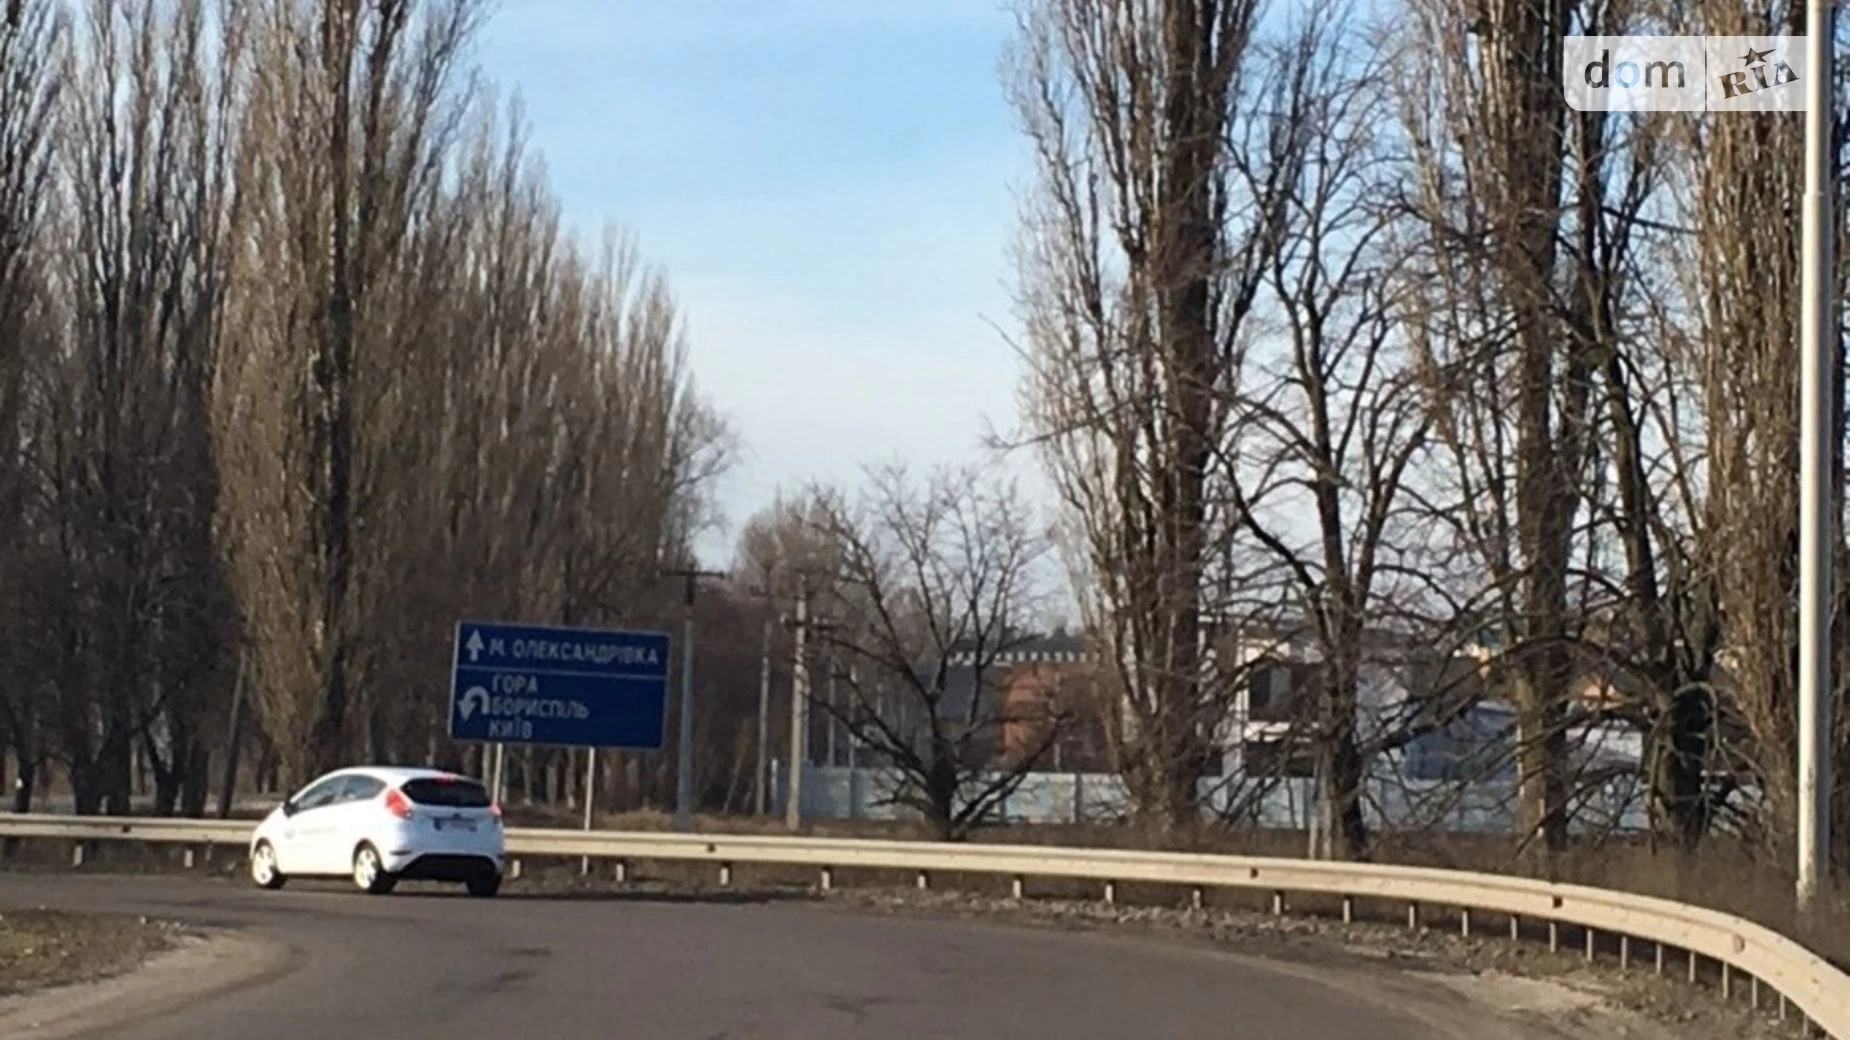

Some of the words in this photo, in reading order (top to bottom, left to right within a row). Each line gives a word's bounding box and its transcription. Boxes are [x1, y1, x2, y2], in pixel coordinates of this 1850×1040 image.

[512, 638, 660, 665] ОЛЕКСАНДРІВКА
[492, 674, 538, 693] ГОРА
[491, 697, 590, 719] БОРИСПІЛЬ
[488, 717, 533, 739] КИЇВ
